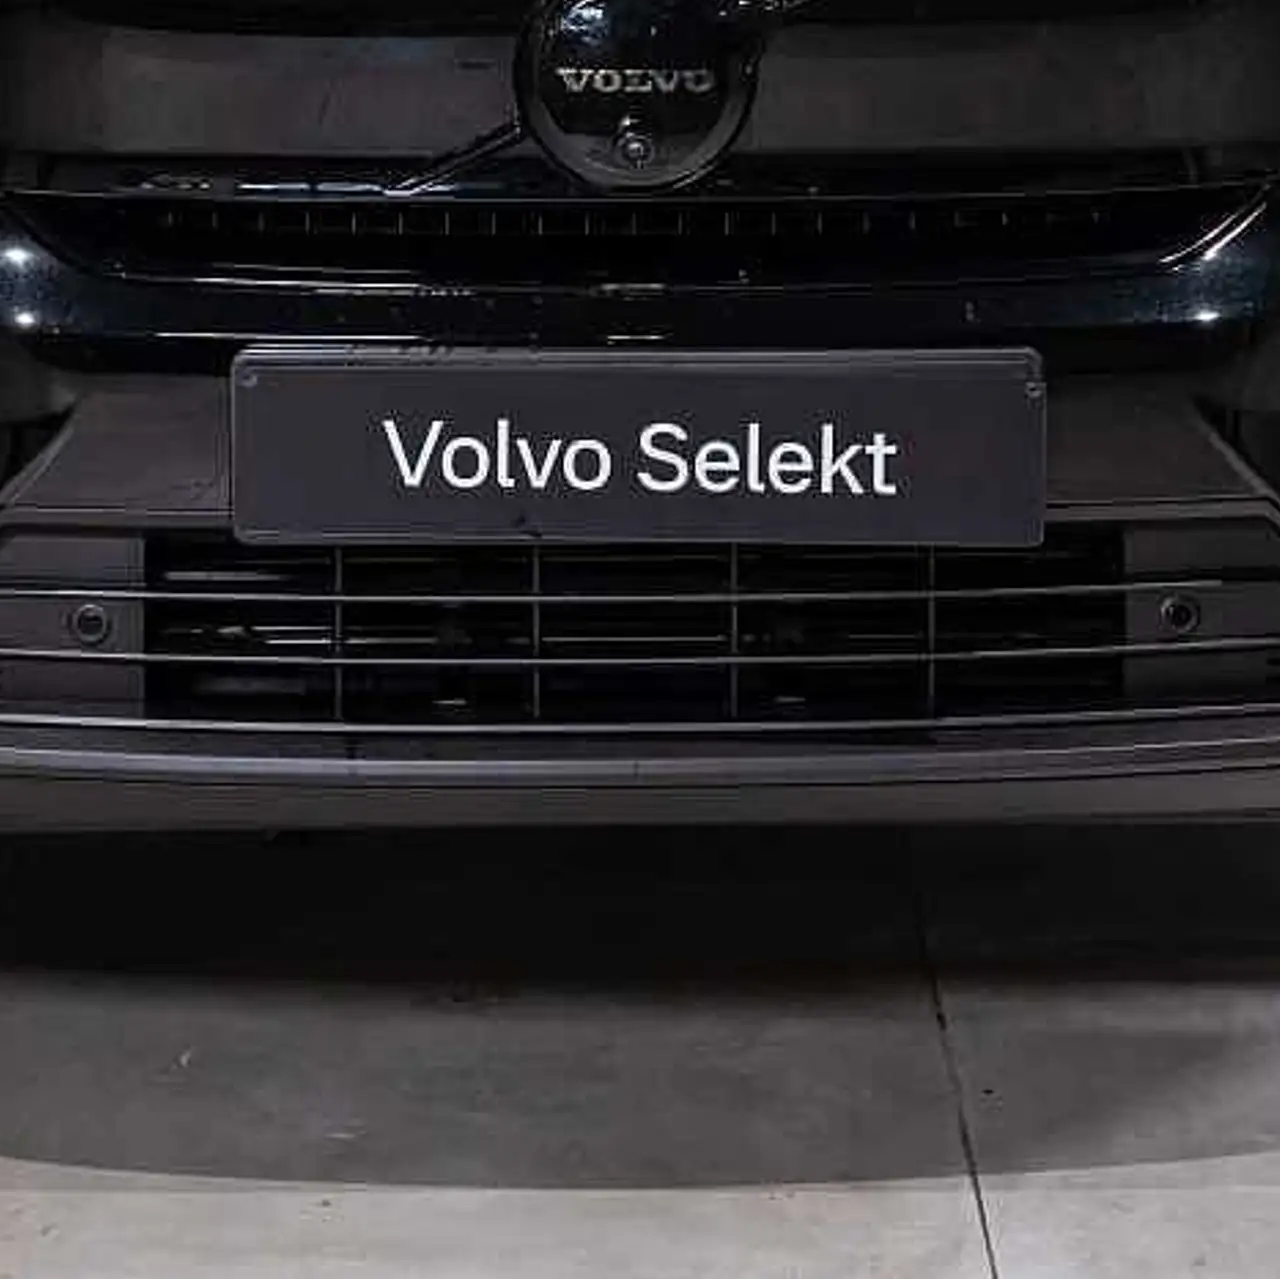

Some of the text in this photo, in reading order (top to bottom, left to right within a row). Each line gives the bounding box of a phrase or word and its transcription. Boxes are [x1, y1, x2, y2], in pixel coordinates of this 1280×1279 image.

[556, 68, 716, 93] VOLVO
[382, 419, 898, 495] Volvo Selekt
